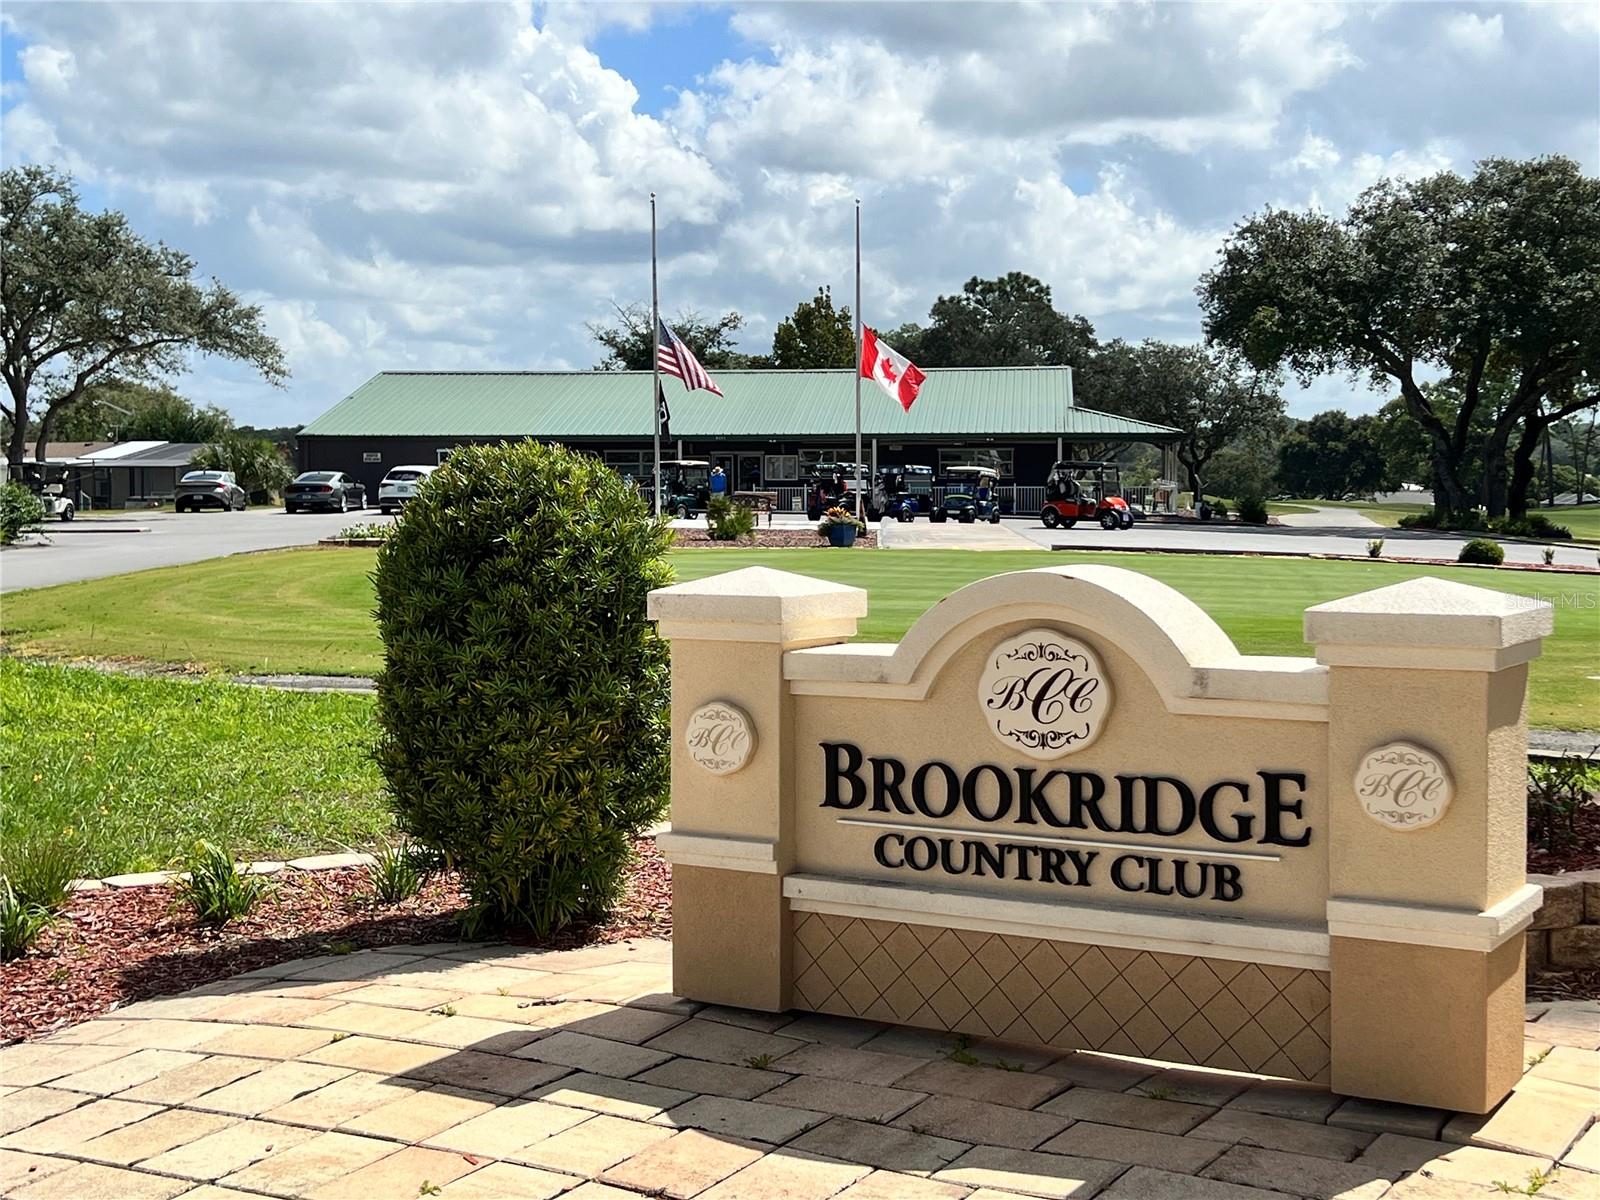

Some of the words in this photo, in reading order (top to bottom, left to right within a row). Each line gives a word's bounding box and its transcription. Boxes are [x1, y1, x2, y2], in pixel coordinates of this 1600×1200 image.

[818, 742, 1312, 848] BROOKRIDGE
[874, 833, 1099, 887] COUNTRY
[1110, 855, 1243, 902] CLUB
